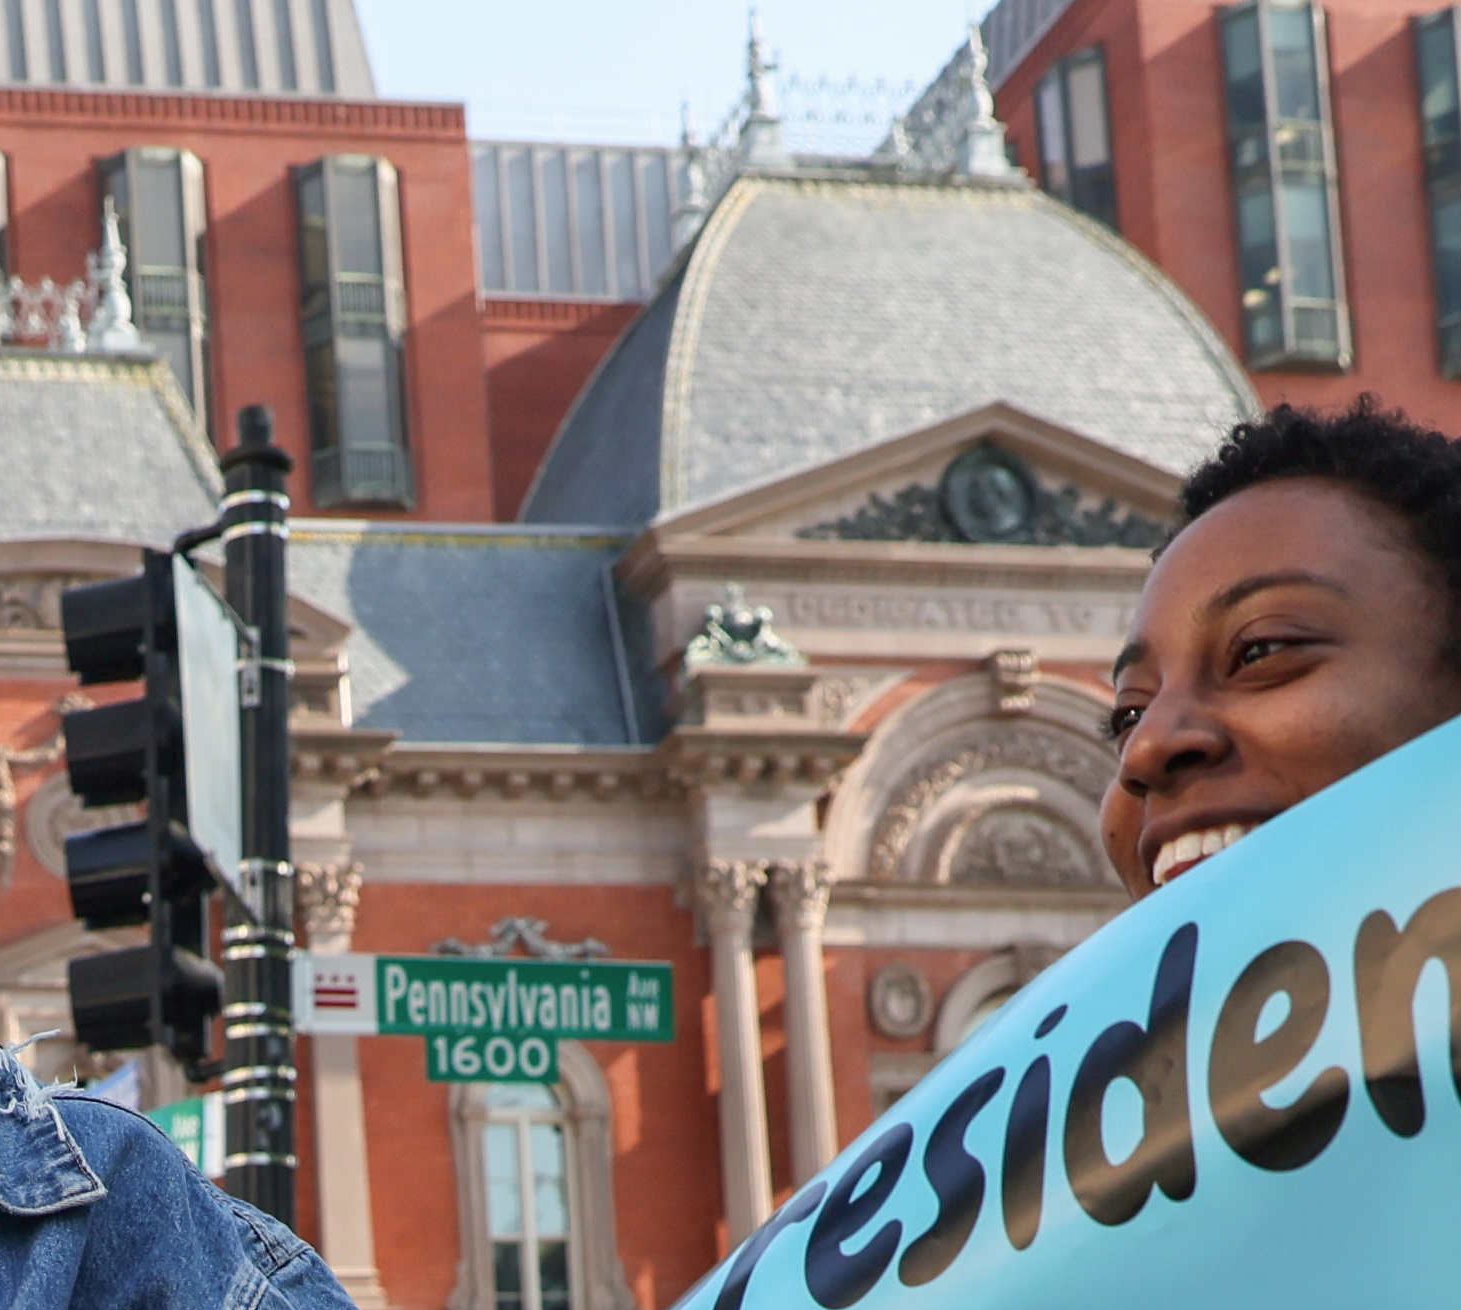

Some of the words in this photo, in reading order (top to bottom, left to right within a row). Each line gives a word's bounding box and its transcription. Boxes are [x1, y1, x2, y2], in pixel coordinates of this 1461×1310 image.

[384, 964, 612, 1032] Pennsylvania
[628, 970, 660, 999] Ave
[627, 1003, 660, 1031] NW
[433, 1035, 551, 1078] 1600
